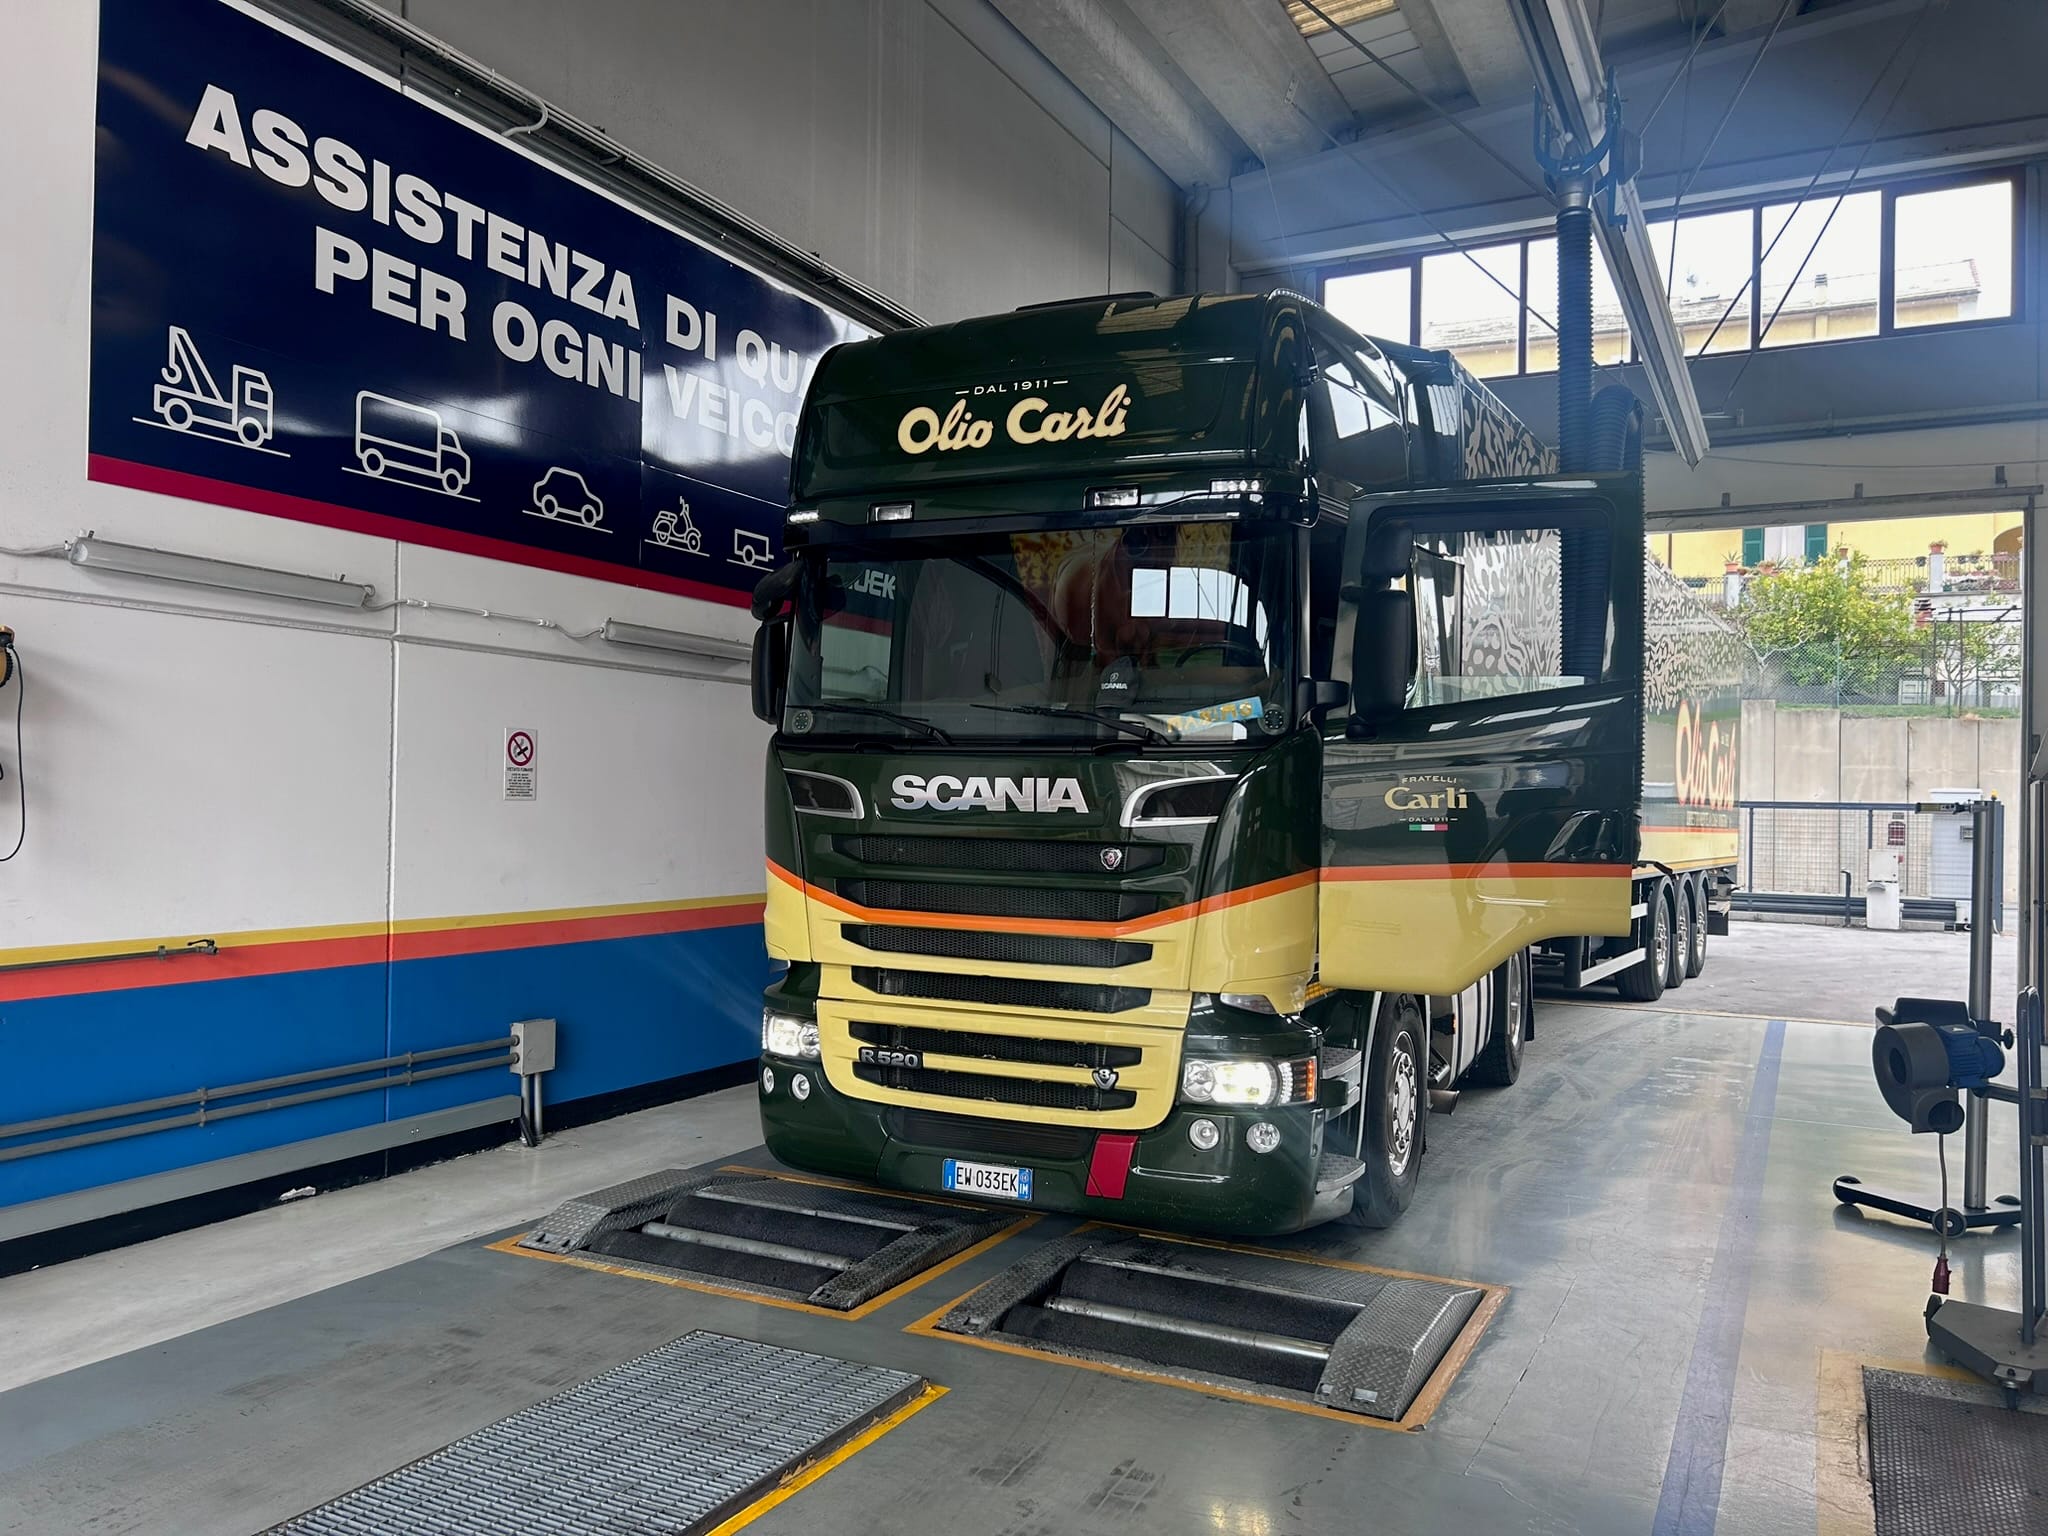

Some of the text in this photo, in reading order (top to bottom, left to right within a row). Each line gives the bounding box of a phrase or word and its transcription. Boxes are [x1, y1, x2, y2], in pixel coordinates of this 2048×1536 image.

[185, 83, 640, 331] ASSISTENZA
[666, 293, 717, 362] DI
[315, 225, 467, 342] PER
[492, 300, 641, 403] OGNI
[974, 378, 1049, 396] DAL 1911
[897, 383, 1132, 455] Olio Carli
[890, 774, 1090, 814] SCANIA
[1401, 775, 1457, 784] FRATELLI
[1384, 786, 1469, 811] Carli
[861, 1048, 919, 1067] R 520
